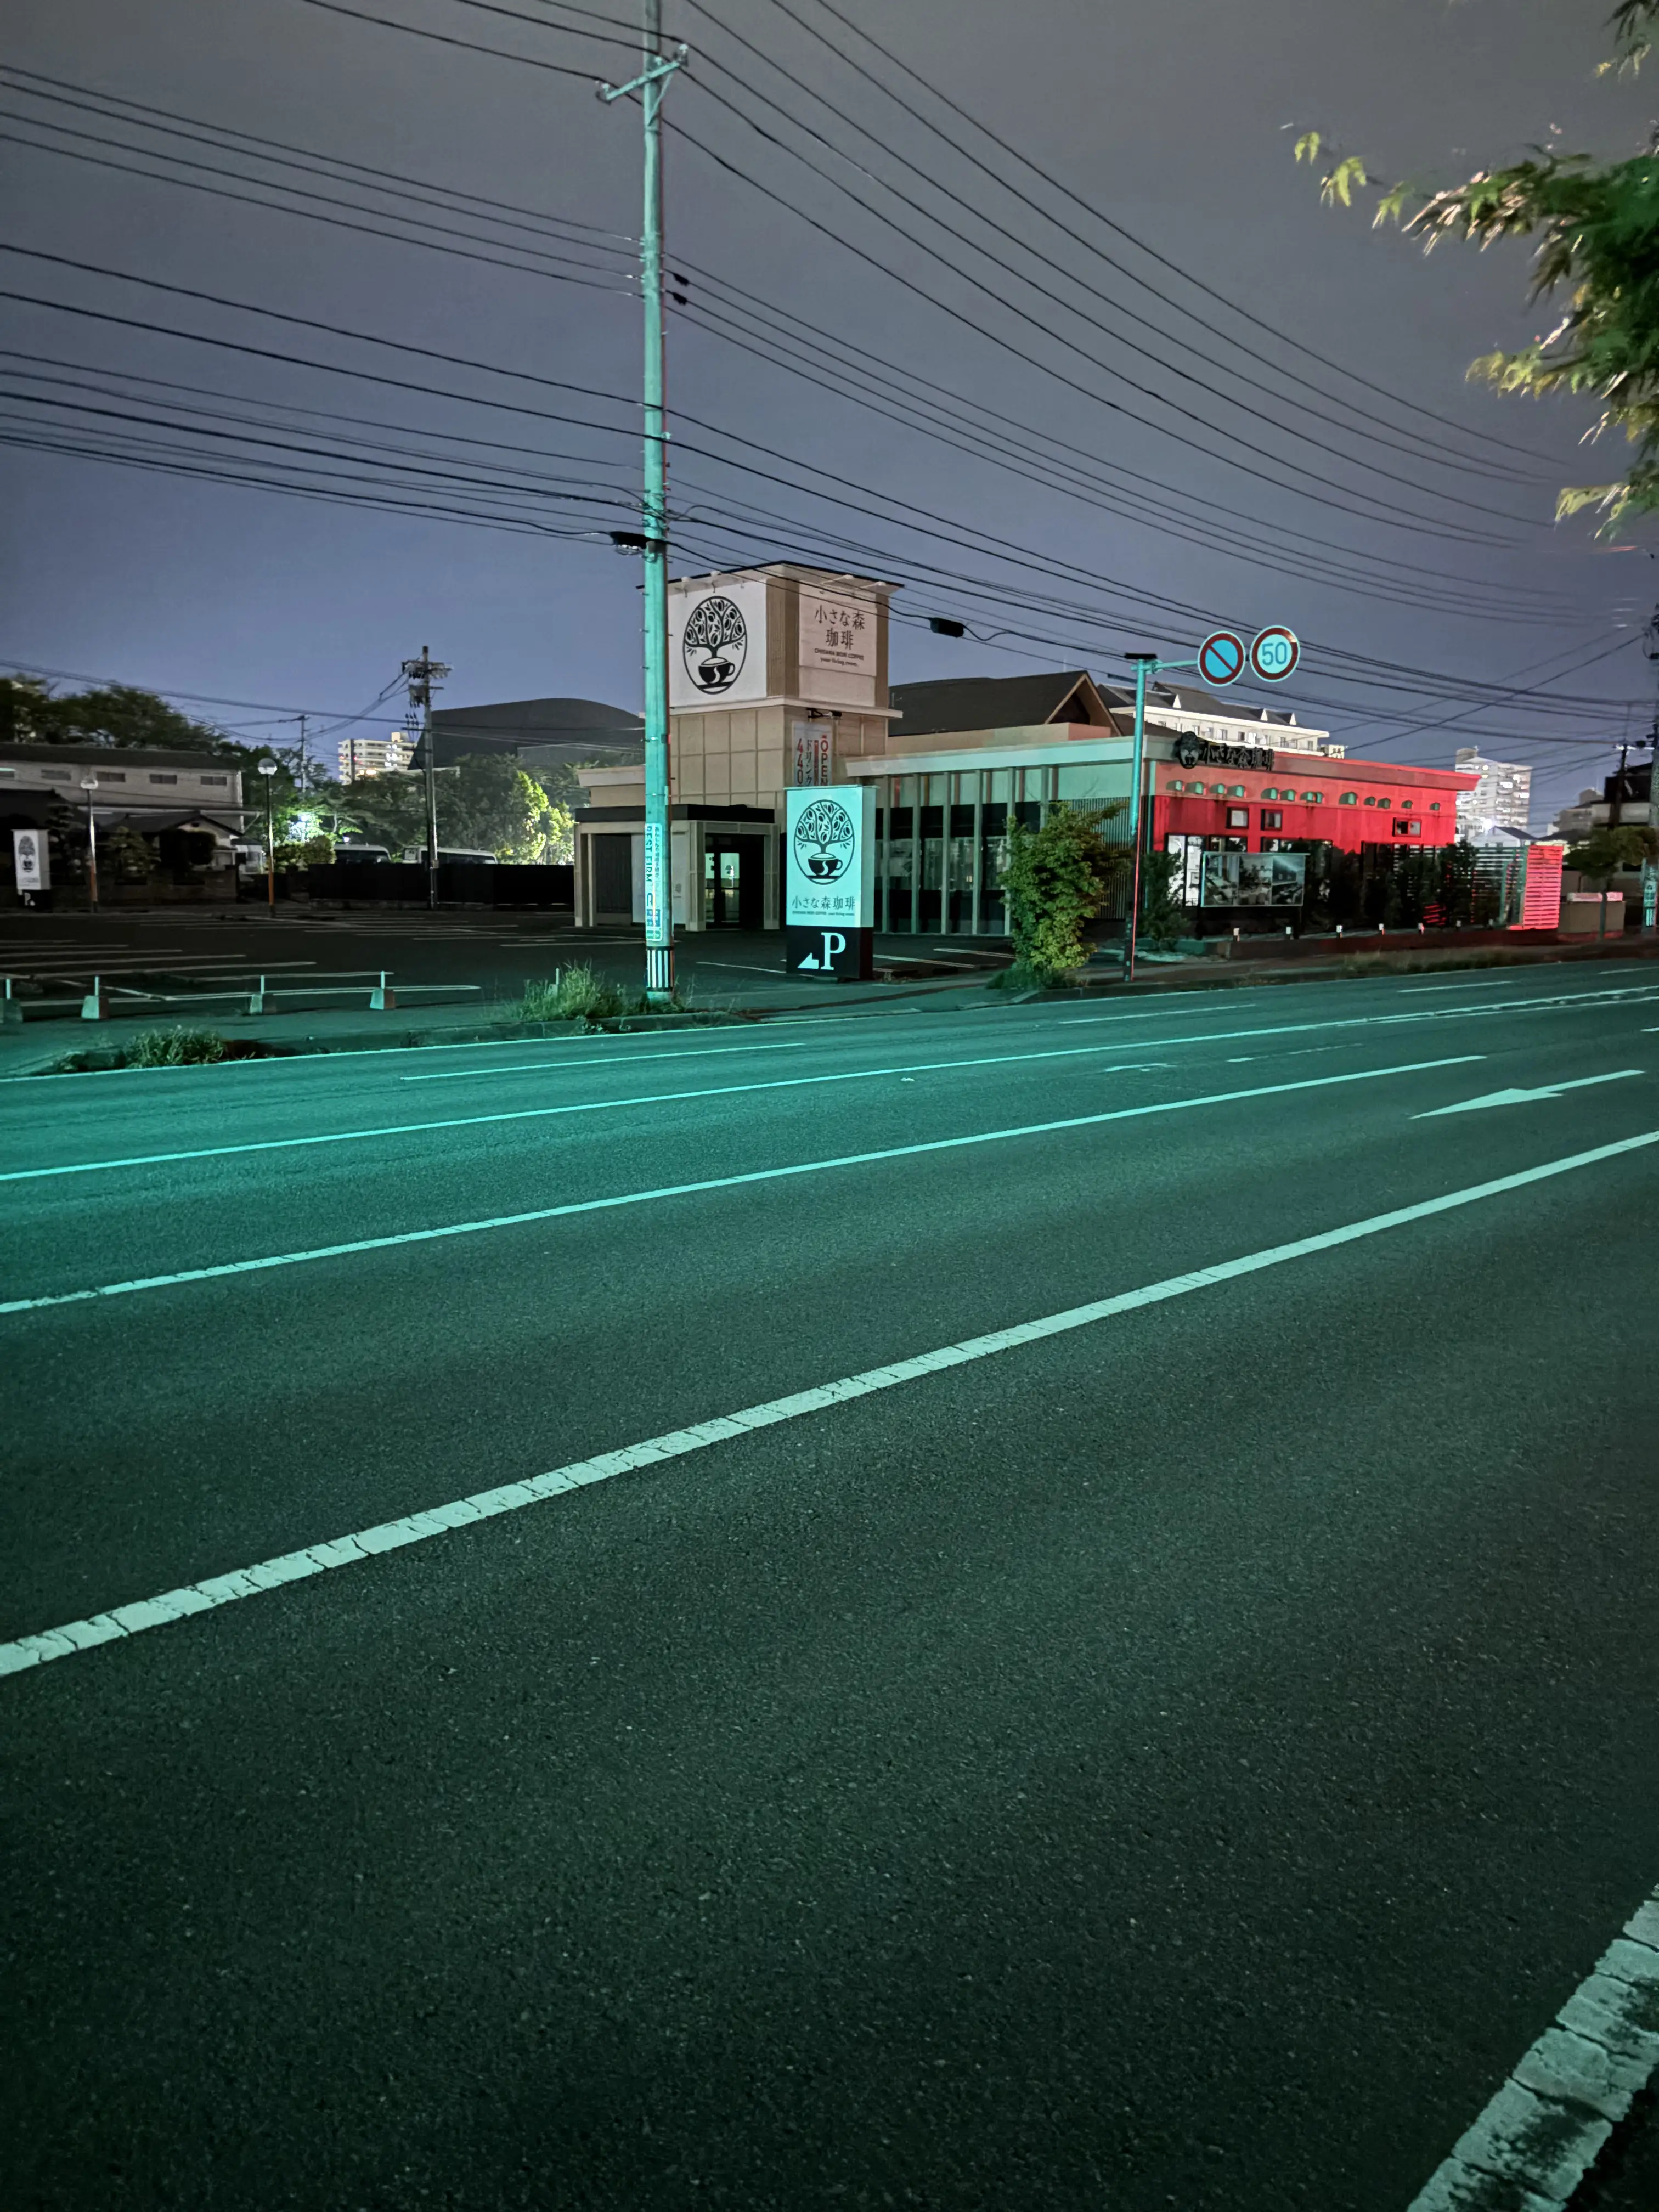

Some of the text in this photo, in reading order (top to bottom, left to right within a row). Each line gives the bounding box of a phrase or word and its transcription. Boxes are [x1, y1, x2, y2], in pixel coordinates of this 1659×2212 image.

[814, 604, 865, 630] 小さな森
[826, 628, 854, 650] 珈琲
[1262, 642, 1288, 665] 50
[820, 740, 828, 786] OPEN
[792, 895, 855, 910] 小さな森珈琲
[821, 932, 845, 970] P
